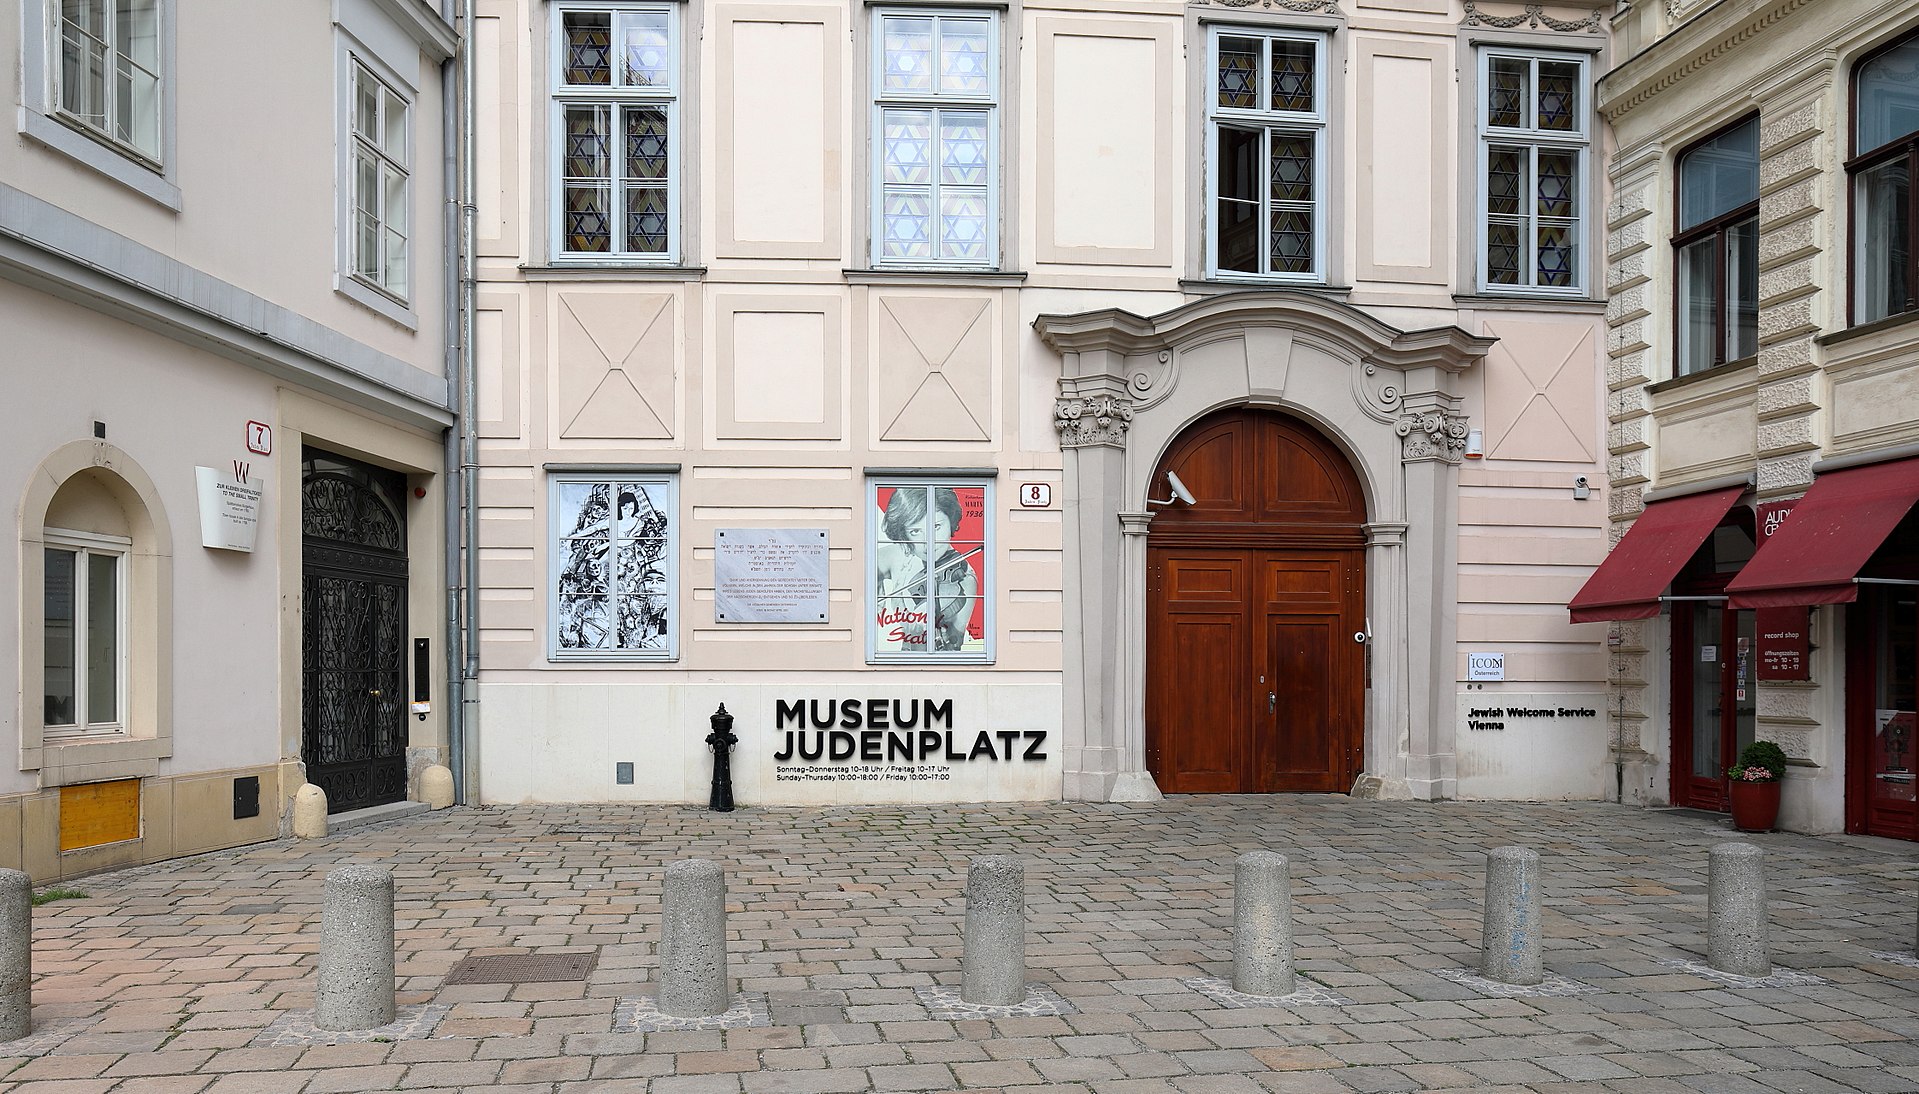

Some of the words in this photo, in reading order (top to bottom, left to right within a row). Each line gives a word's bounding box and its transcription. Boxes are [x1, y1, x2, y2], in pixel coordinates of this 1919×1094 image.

[256, 427, 264, 445] 7
[233, 459, 250, 485] W
[1031, 486, 1041, 500] 8
[965, 510, 984, 518] 1936
[1765, 509, 1794, 525] AUD
[1784, 632, 1800, 640] shop
[1471, 657, 1503, 669] ICOM
[776, 699, 953, 729] MUSEUM
[1467, 707, 1504, 718] Jewish
[1506, 707, 1556, 717] Welcome
[1557, 707, 1597, 717] Service
[1467, 720, 1505, 731] Vienna
[773, 730, 1047, 761] JUDENPLATZ
[776, 774, 836, 782] Sunday-Thursday
[886, 774, 908, 782] Friday
